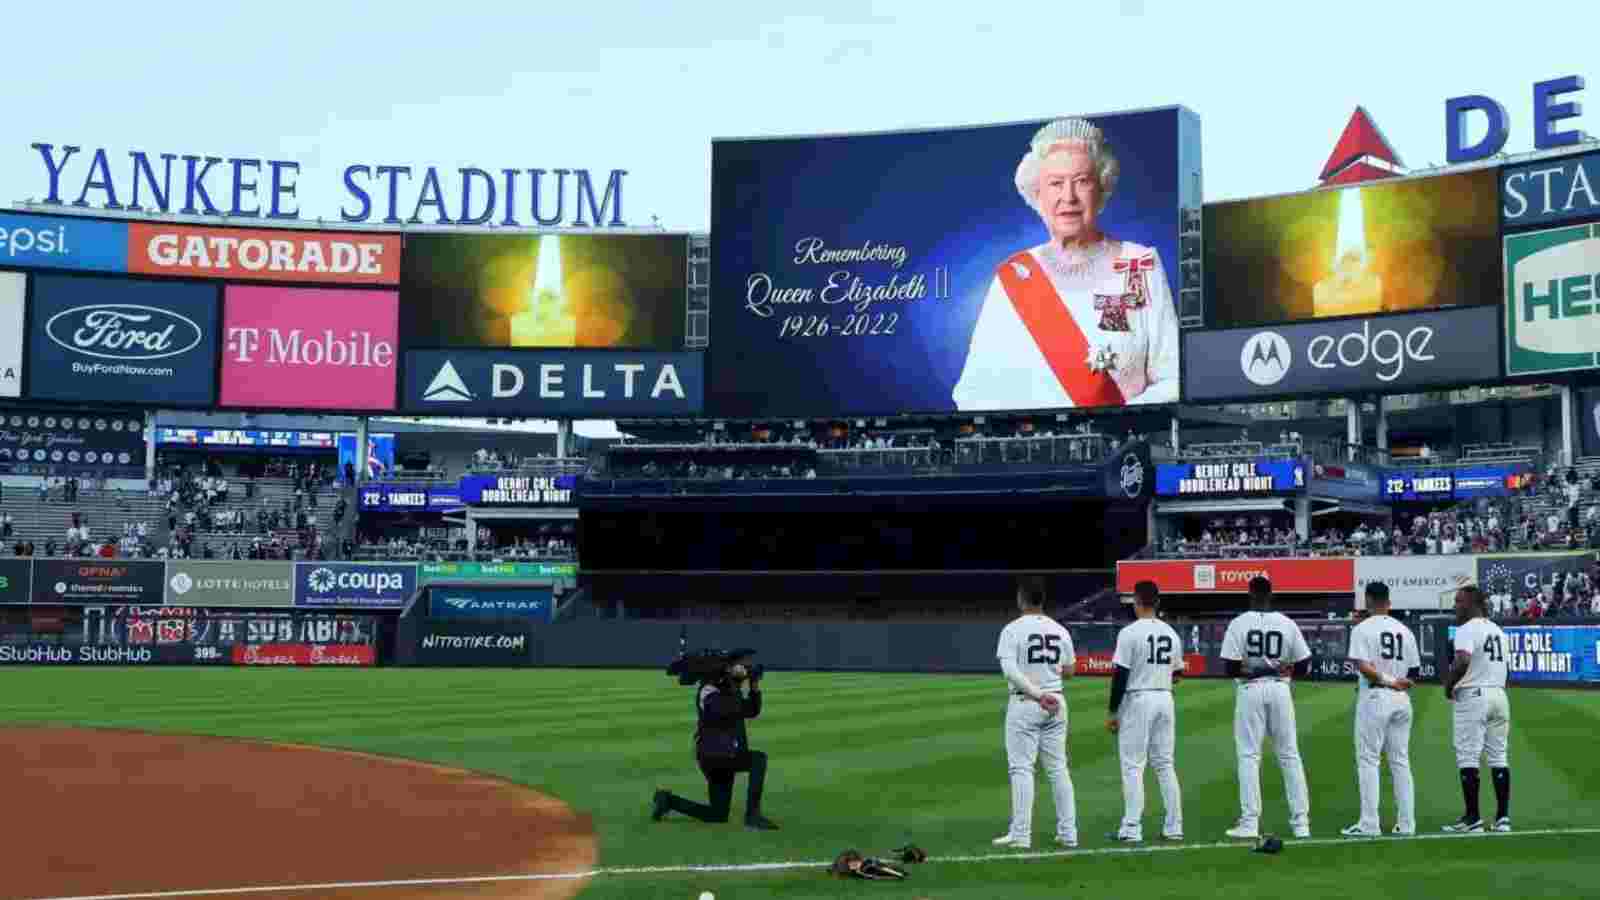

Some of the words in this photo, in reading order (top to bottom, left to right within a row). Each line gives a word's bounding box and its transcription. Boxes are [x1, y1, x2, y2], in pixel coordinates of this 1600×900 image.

[31, 143, 300, 219] YANKEE
[341, 165, 629, 227] STADIUM
[1504, 164, 1600, 218] STA
[147, 234, 384, 274] GATORADE
[794, 237, 907, 268] Remembering
[745, 272, 816, 317] Queen
[820, 270, 927, 312] Elizabeth
[1523, 273, 1600, 322] HE
[74, 310, 175, 350] Ford
[779, 312, 899, 339] 1926-2022
[264, 327, 393, 368] Mobile
[1307, 321, 1435, 381] edge
[72, 362, 174, 376] BuyFordNow.com
[492, 363, 687, 398] DELTA
[338, 571, 402, 594] coupa
[471, 600, 538, 608] AMTRAK
[0, 646, 72, 661] StubHub
[80, 646, 151, 661] StubHub
[422, 635, 525, 648] NITTOTIRE.COM
[1028, 634, 1061, 664] 25
[1147, 634, 1172, 664] 12
[1247, 630, 1283, 658] 90
[1380, 632, 1403, 661] 91
[1484, 634, 1503, 661] 41
[1524, 632, 1552, 652] COLE
[1537, 652, 1572, 672] NIGHT
